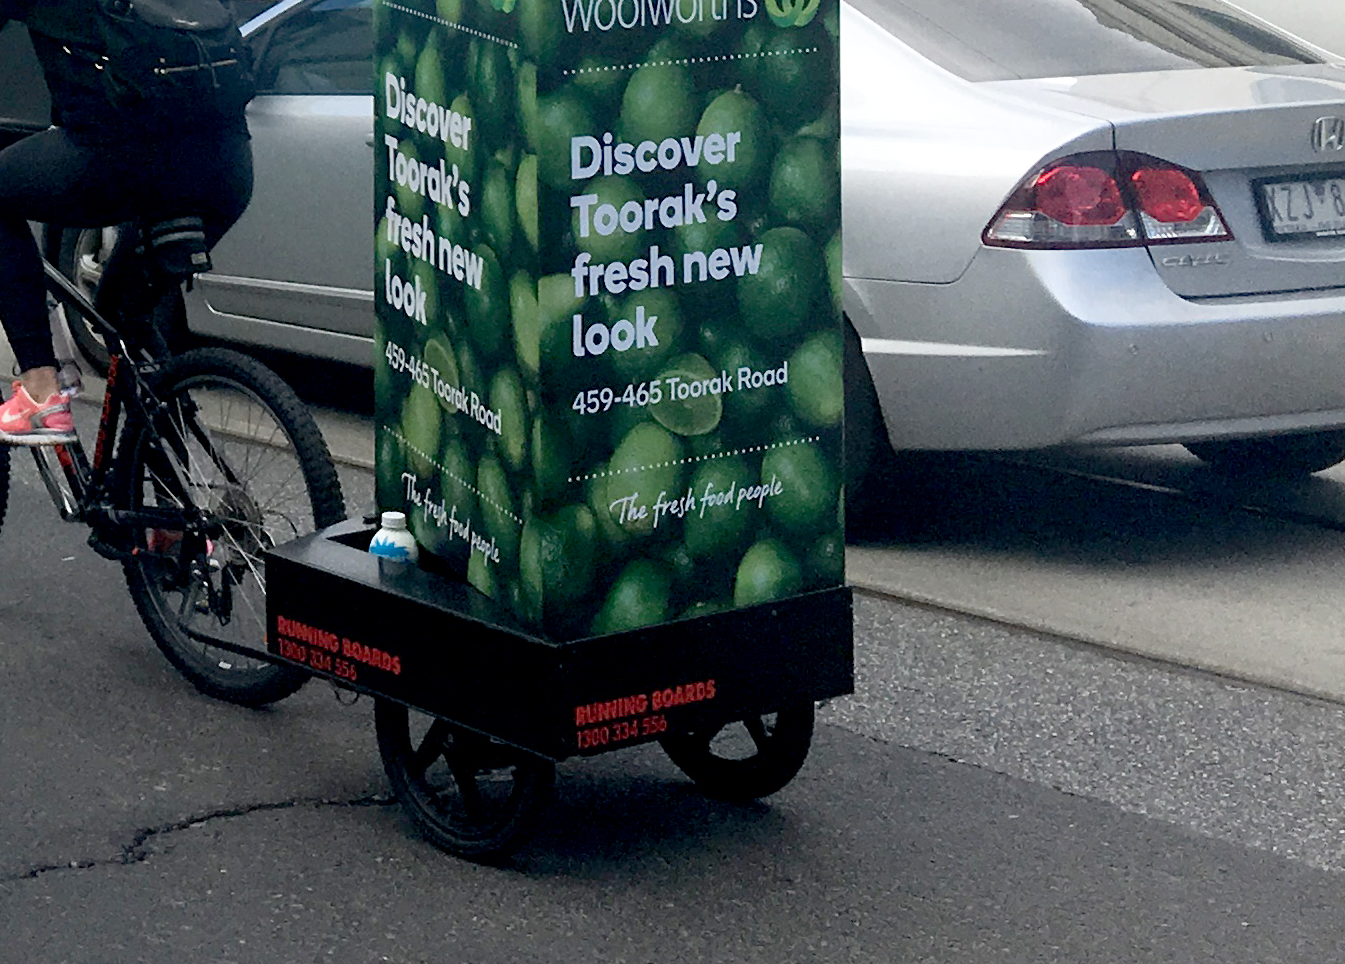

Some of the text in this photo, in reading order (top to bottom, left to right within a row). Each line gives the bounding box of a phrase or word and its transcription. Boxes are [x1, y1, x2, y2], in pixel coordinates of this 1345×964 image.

[385, 71, 472, 151] Discover
[385, 135, 470, 217] Toorak's
[570, 129, 741, 180] Discover
[570, 180, 737, 237] Toorak's
[385, 197, 484, 291] fresh new
[571, 243, 764, 298] fresh new
[385, 258, 428, 325] look
[572, 306, 659, 357] look
[385, 341, 502, 435] 459-465 Toorak Road
[571, 361, 789, 415] 459-465 Toorak Road
[402, 473, 500, 564] The fresh food people
[609, 473, 784, 528] The fresh food people
[277, 615, 401, 675] RUNNING BOARDS
[575, 679, 716, 727] RUNNING BOARDS
[577, 727, 610, 749] 1300
